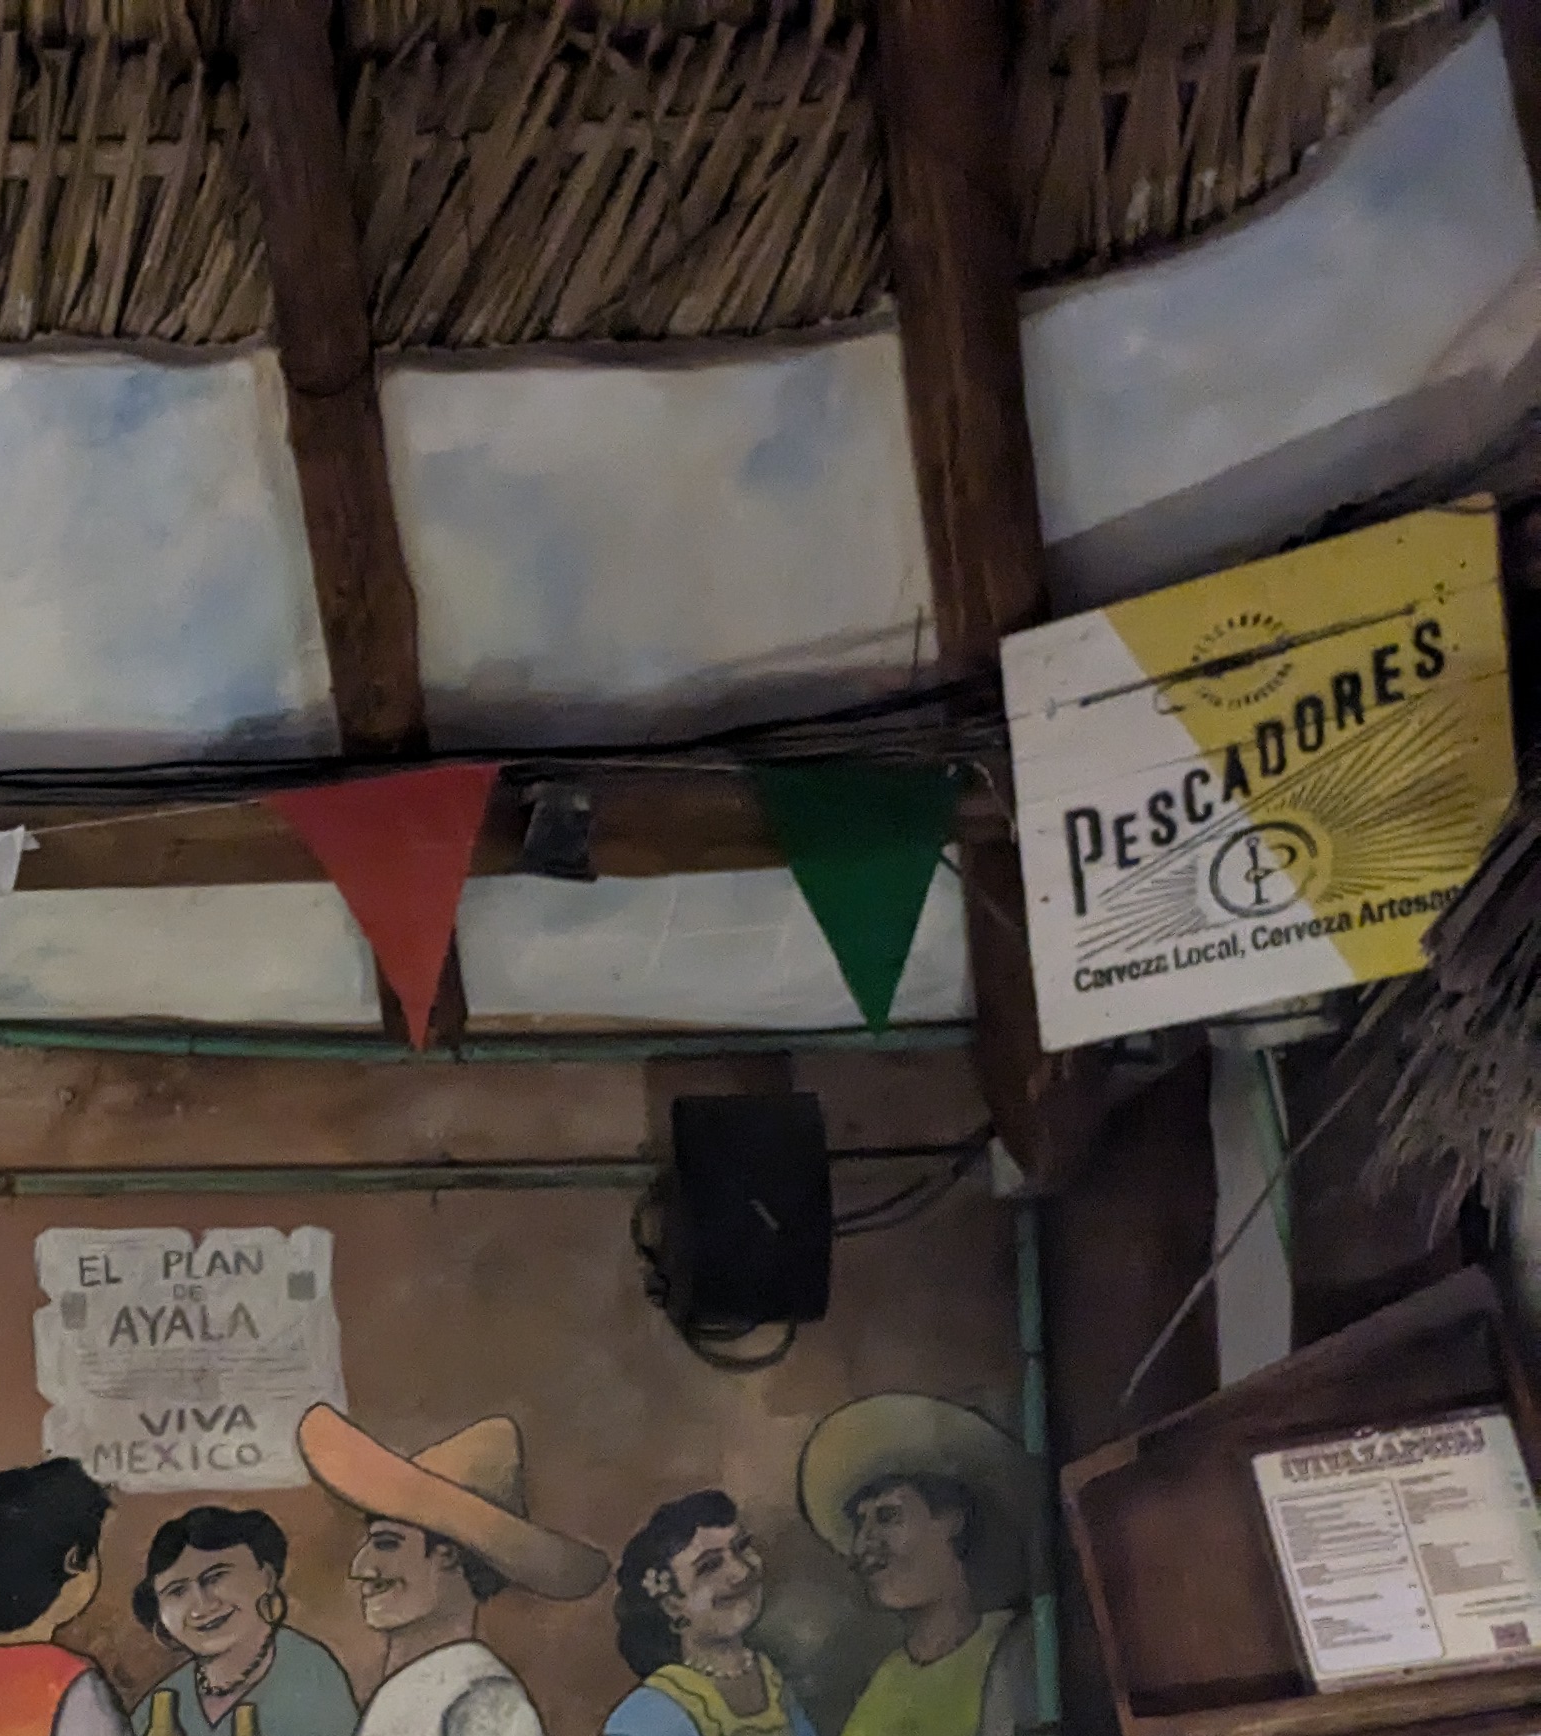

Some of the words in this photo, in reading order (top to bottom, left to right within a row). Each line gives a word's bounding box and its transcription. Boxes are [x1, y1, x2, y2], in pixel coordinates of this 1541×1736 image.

[1064, 619, 1446, 917] PESCADORES
[1073, 954, 1168, 992] Cerveza
[1173, 935, 1246, 969] Local,
[1251, 915, 1353, 949] Cerveza
[78, 1255, 122, 1288] EL
[162, 1250, 264, 1280] PLAN
[173, 1283, 204, 1302] DE
[109, 1302, 260, 1346] AYALA
[139, 1403, 257, 1437] VIVA
[92, 1440, 263, 1474] MEXICO
